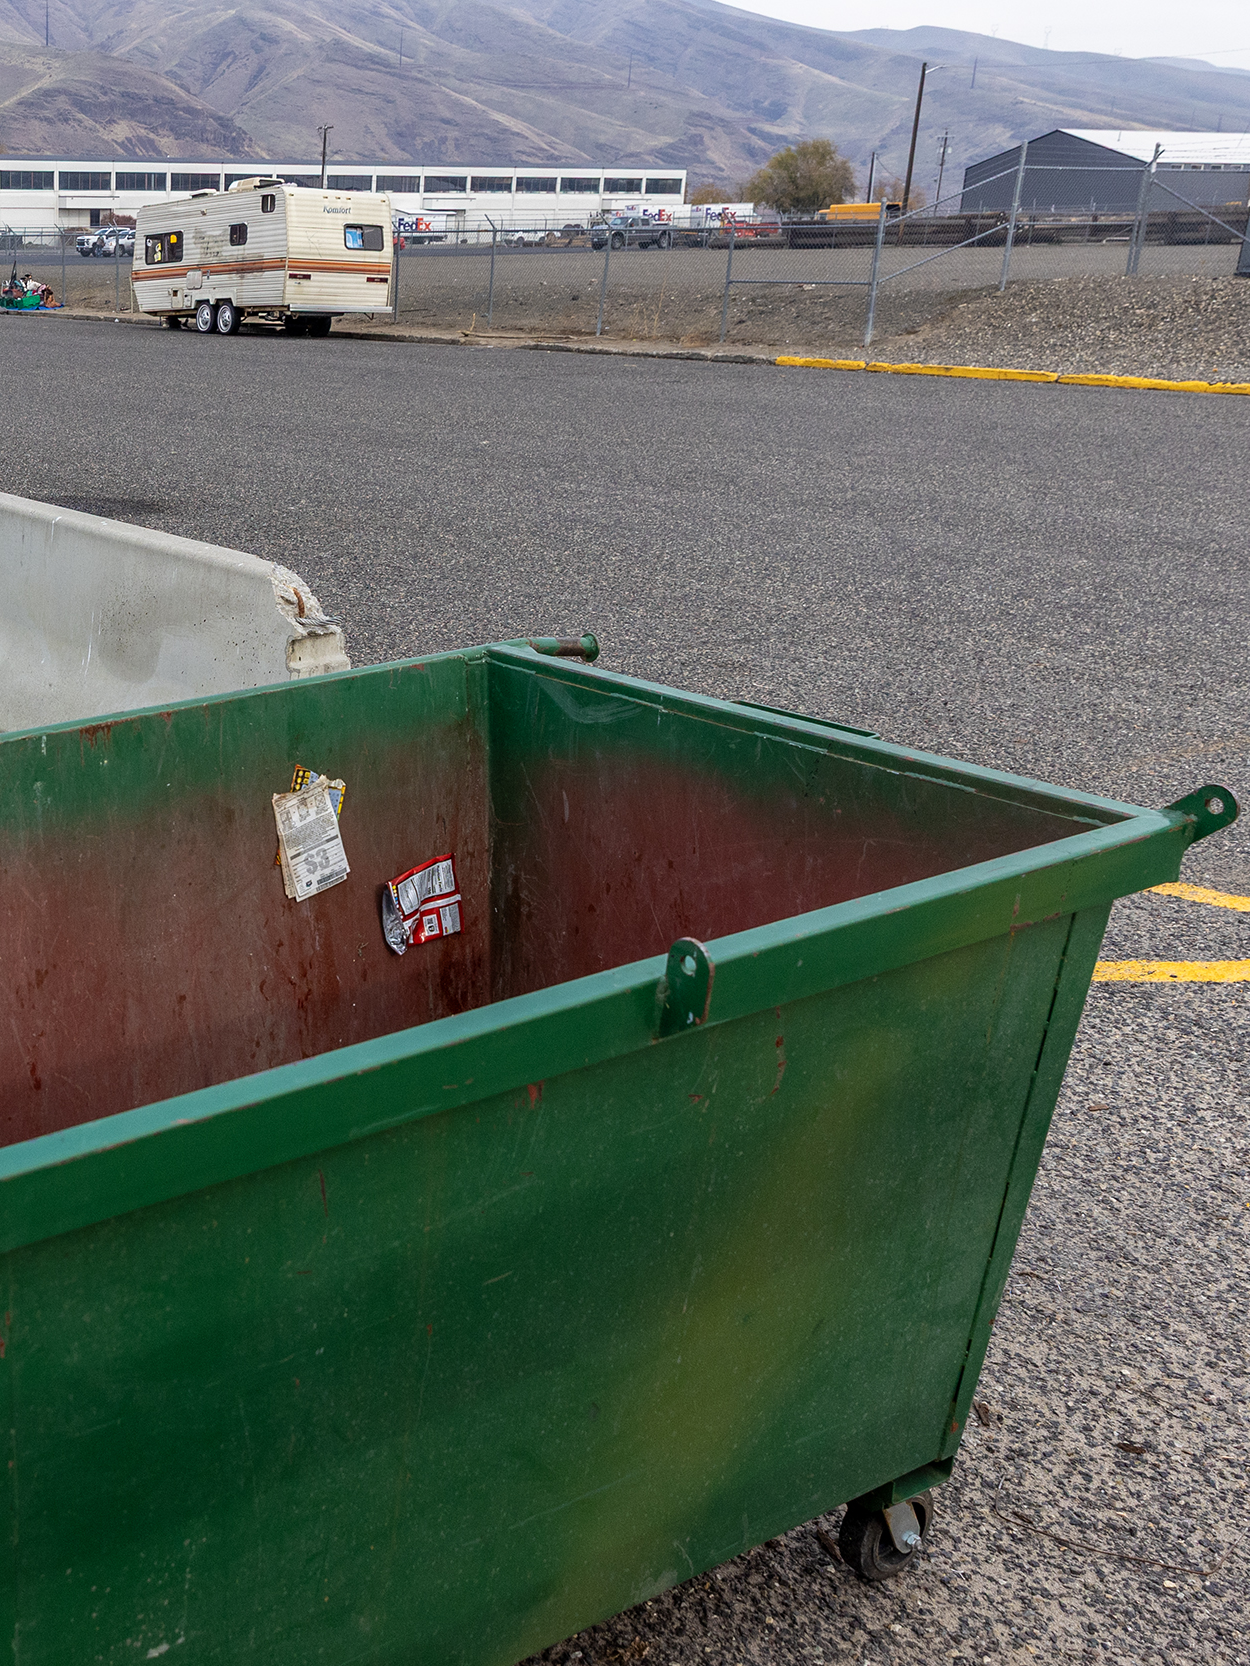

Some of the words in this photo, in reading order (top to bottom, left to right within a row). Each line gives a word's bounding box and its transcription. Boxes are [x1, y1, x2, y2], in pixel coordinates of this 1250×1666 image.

[323, 205, 351, 214] Komfort
[398, 217, 432, 231] FedEx
[304, 847, 331, 875] $3
